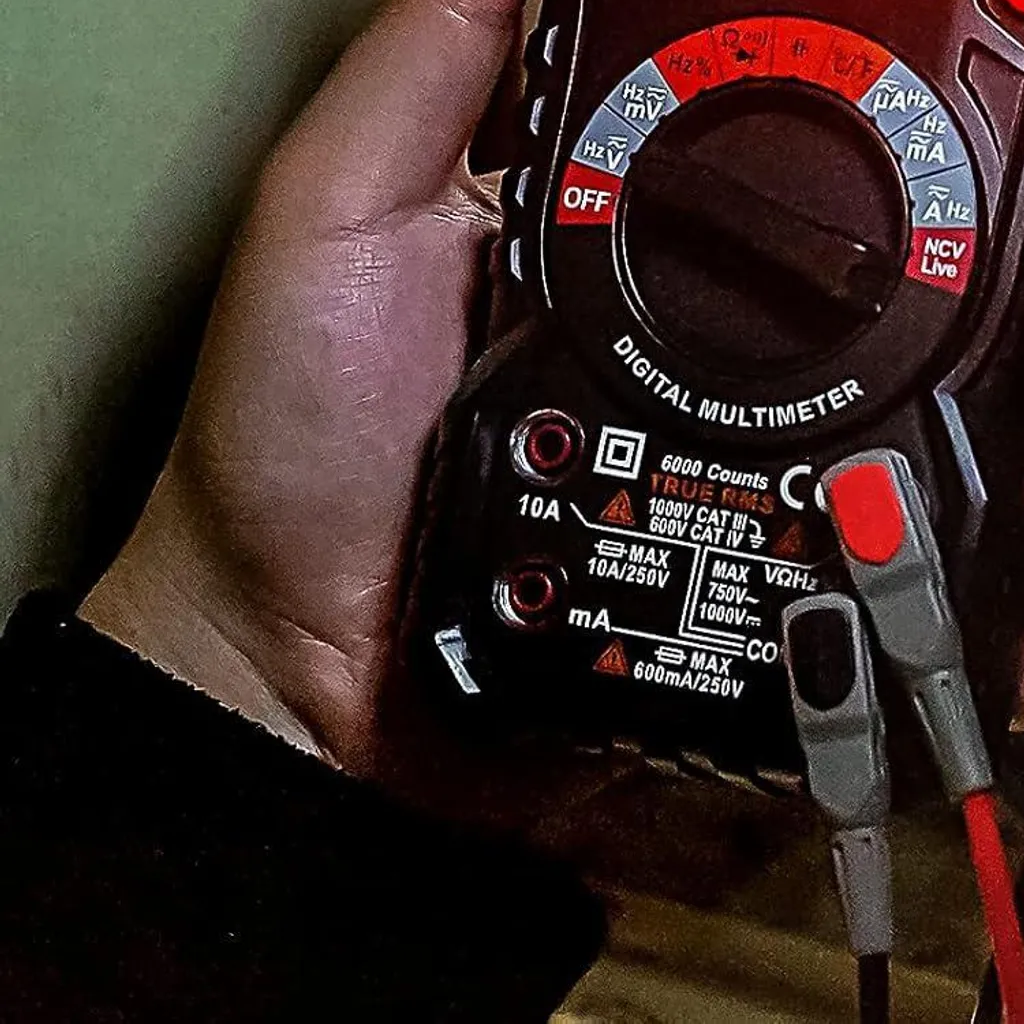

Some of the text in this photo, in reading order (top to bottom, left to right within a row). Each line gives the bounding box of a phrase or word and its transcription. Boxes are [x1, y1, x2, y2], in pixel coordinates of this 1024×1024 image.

[623, 82, 645, 102] Hz
[906, 88, 931, 110] Hz
[922, 113, 947, 135] Hz
[583, 140, 605, 159] Hz
[563, 186, 612, 213] OFF
[947, 199, 971, 222] Hz
[924, 236, 967, 260] NCV
[920, 255, 959, 280] Live
[612, 334, 865, 428] DIGITAL MULTIMETER
[661, 454, 770, 491] 6000 Counts
[650, 473, 775, 515] TRUE RMS
[517, 493, 561, 523] 10A
[649, 496, 694, 521] 1000V
[696, 507, 732, 528] CAT
[650, 514, 745, 549] 600V CAT IV
[629, 544, 672, 569] MAX
[586, 556, 671, 589] 10A/250V
[711, 559, 751, 584] MAX
[568, 606, 613, 634] mA
[690, 651, 733, 678] MAX
[746, 638, 778, 664] CO
[633, 660, 745, 699] 600mA/250V
